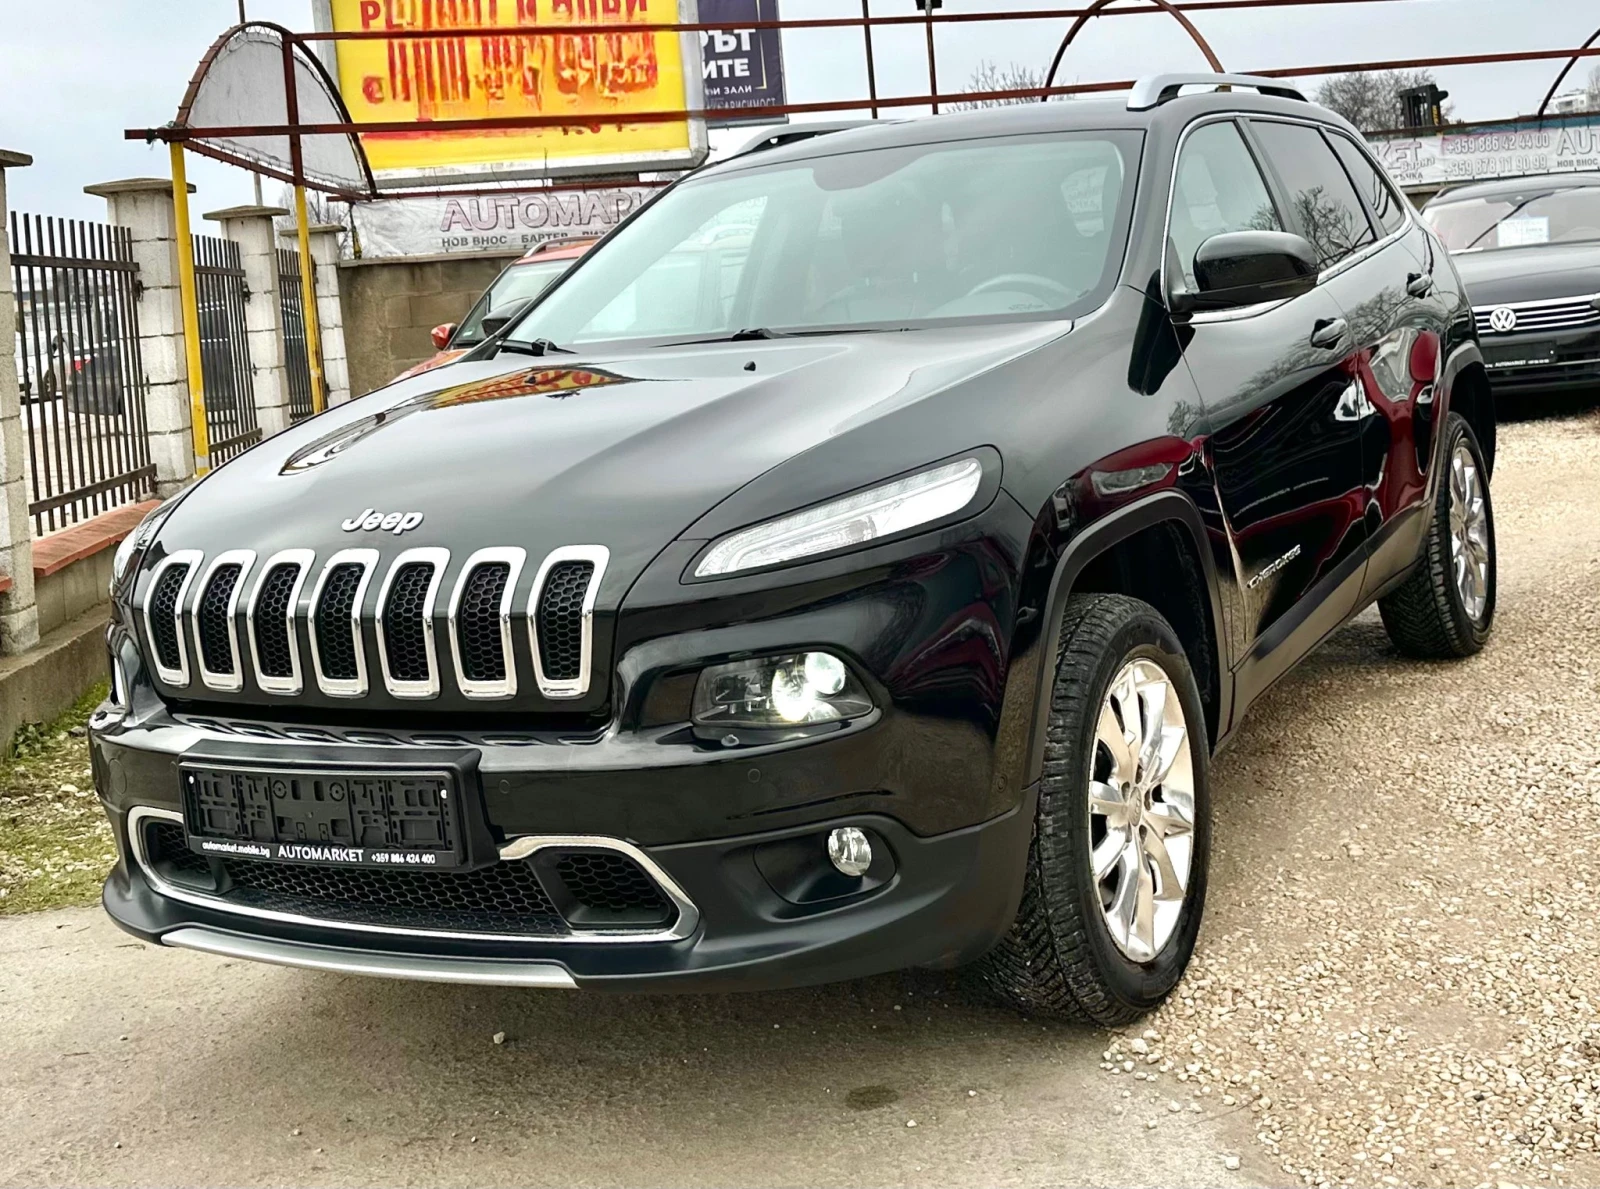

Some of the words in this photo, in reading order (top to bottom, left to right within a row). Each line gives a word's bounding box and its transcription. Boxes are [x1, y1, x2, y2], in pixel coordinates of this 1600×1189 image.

[724, 85, 753, 94] ЗАЛИ
[1446, 138, 1475, 155] +359
[1478, 136, 1499, 153] 886
[1501, 135, 1516, 151] 42
[1519, 134, 1533, 149] 44
[1535, 132, 1549, 148] 00
[1499, 157, 1512, 173] 11
[1516, 155, 1530, 171] 90
[1533, 154, 1547, 169] 99
[442, 236, 468, 247] НОВ
[473, 235, 507, 246] ВНОС
[341, 508, 424, 536] Jeep
[202, 841, 270, 858] automarket.mobile.bg
[278, 844, 364, 863] AUTOMARKET
[371, 852, 389, 863] +359
[406, 853, 420, 863] 424
[421, 853, 436, 864] 400
